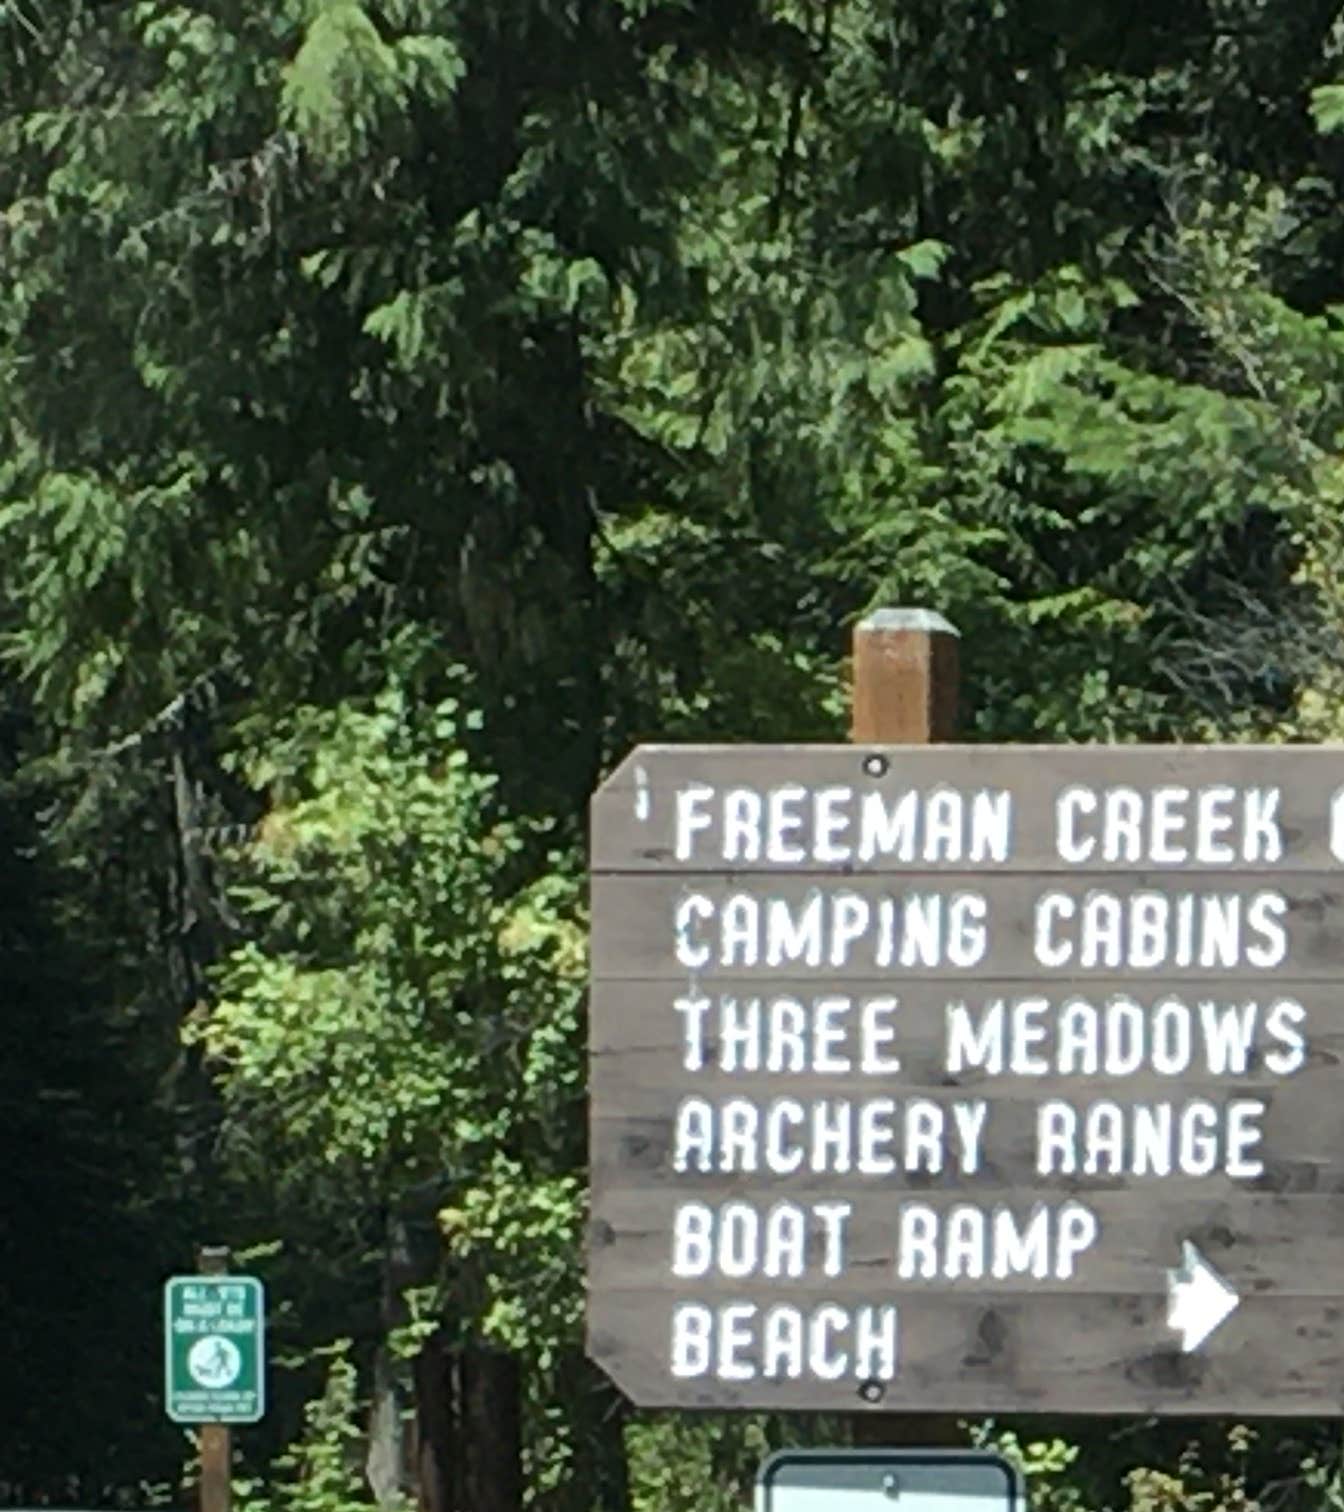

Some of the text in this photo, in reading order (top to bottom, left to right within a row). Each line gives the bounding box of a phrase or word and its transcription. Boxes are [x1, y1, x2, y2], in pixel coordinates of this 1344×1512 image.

[675, 785, 1012, 864] FREEMAN
[1055, 787, 1282, 864] CREEK
[675, 892, 1287, 969] CAMPING CABINS
[672, 997, 1307, 1077] THREE MEADOWS
[673, 1098, 1265, 1178] ARCHERY RANGE
[670, 1203, 1096, 1281] BOAT RAMP
[670, 1303, 896, 1381] BEACH
